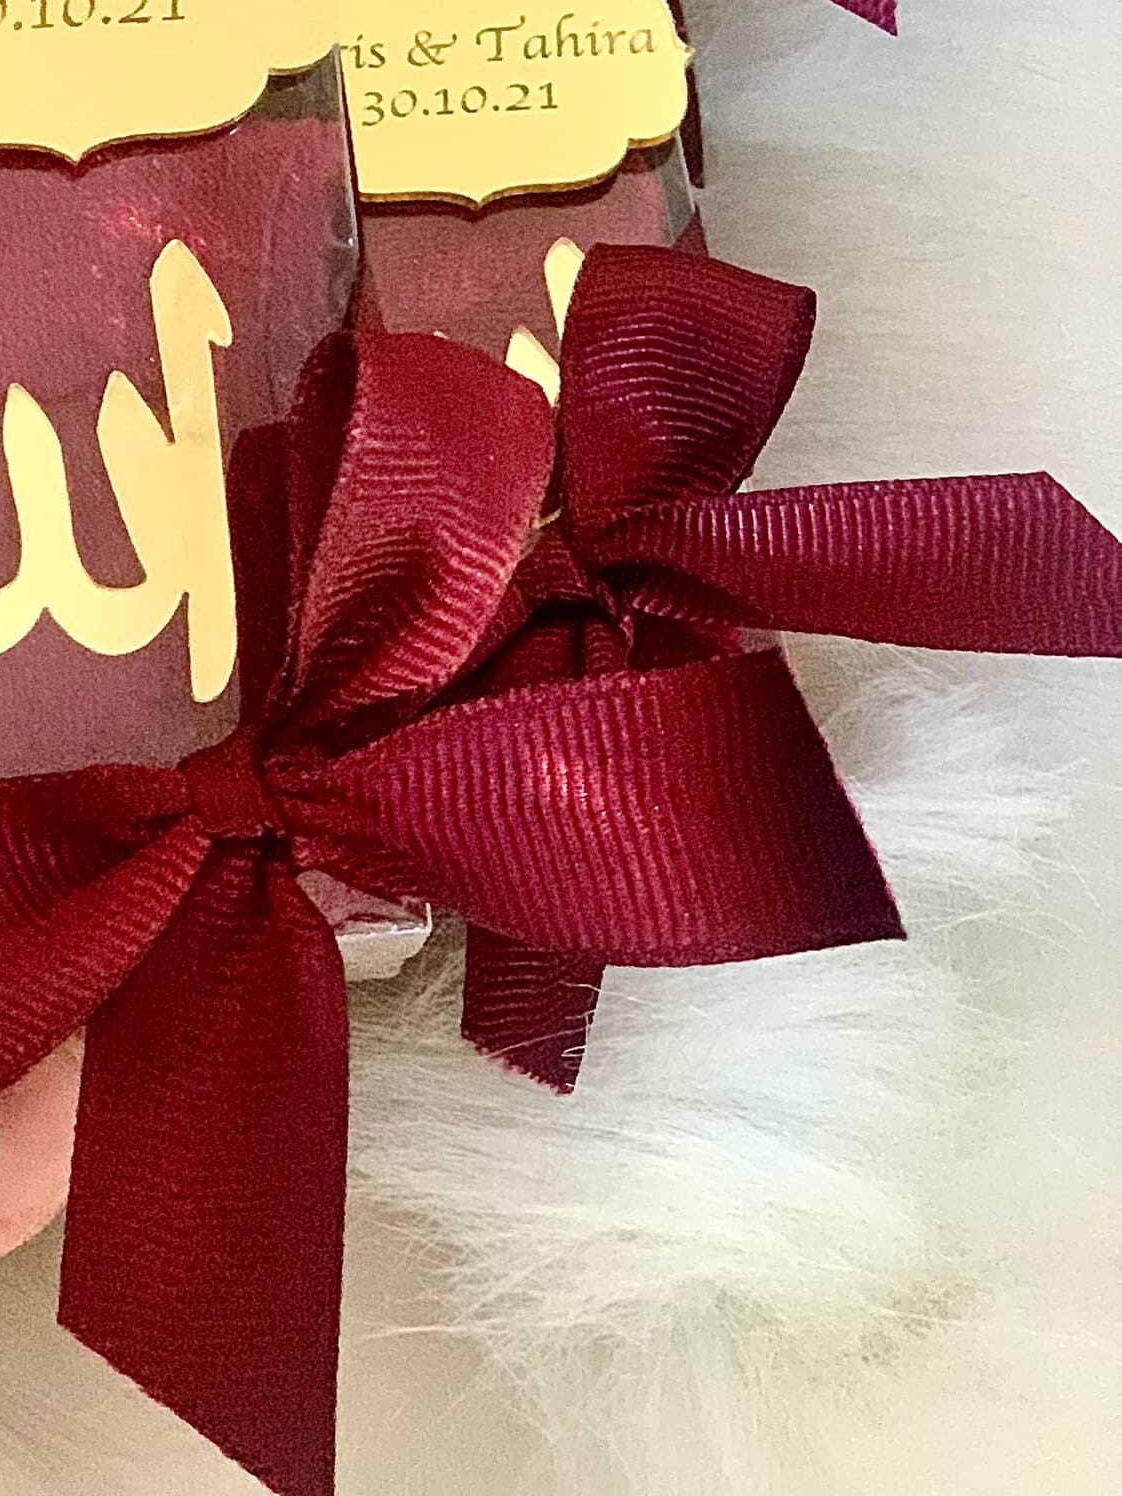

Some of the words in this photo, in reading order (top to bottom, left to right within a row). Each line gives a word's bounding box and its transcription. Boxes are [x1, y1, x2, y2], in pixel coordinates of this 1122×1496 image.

[407, 30, 458, 67] &
[476, 13, 656, 63] Tahira
[361, 82, 558, 128] 30.10.21
